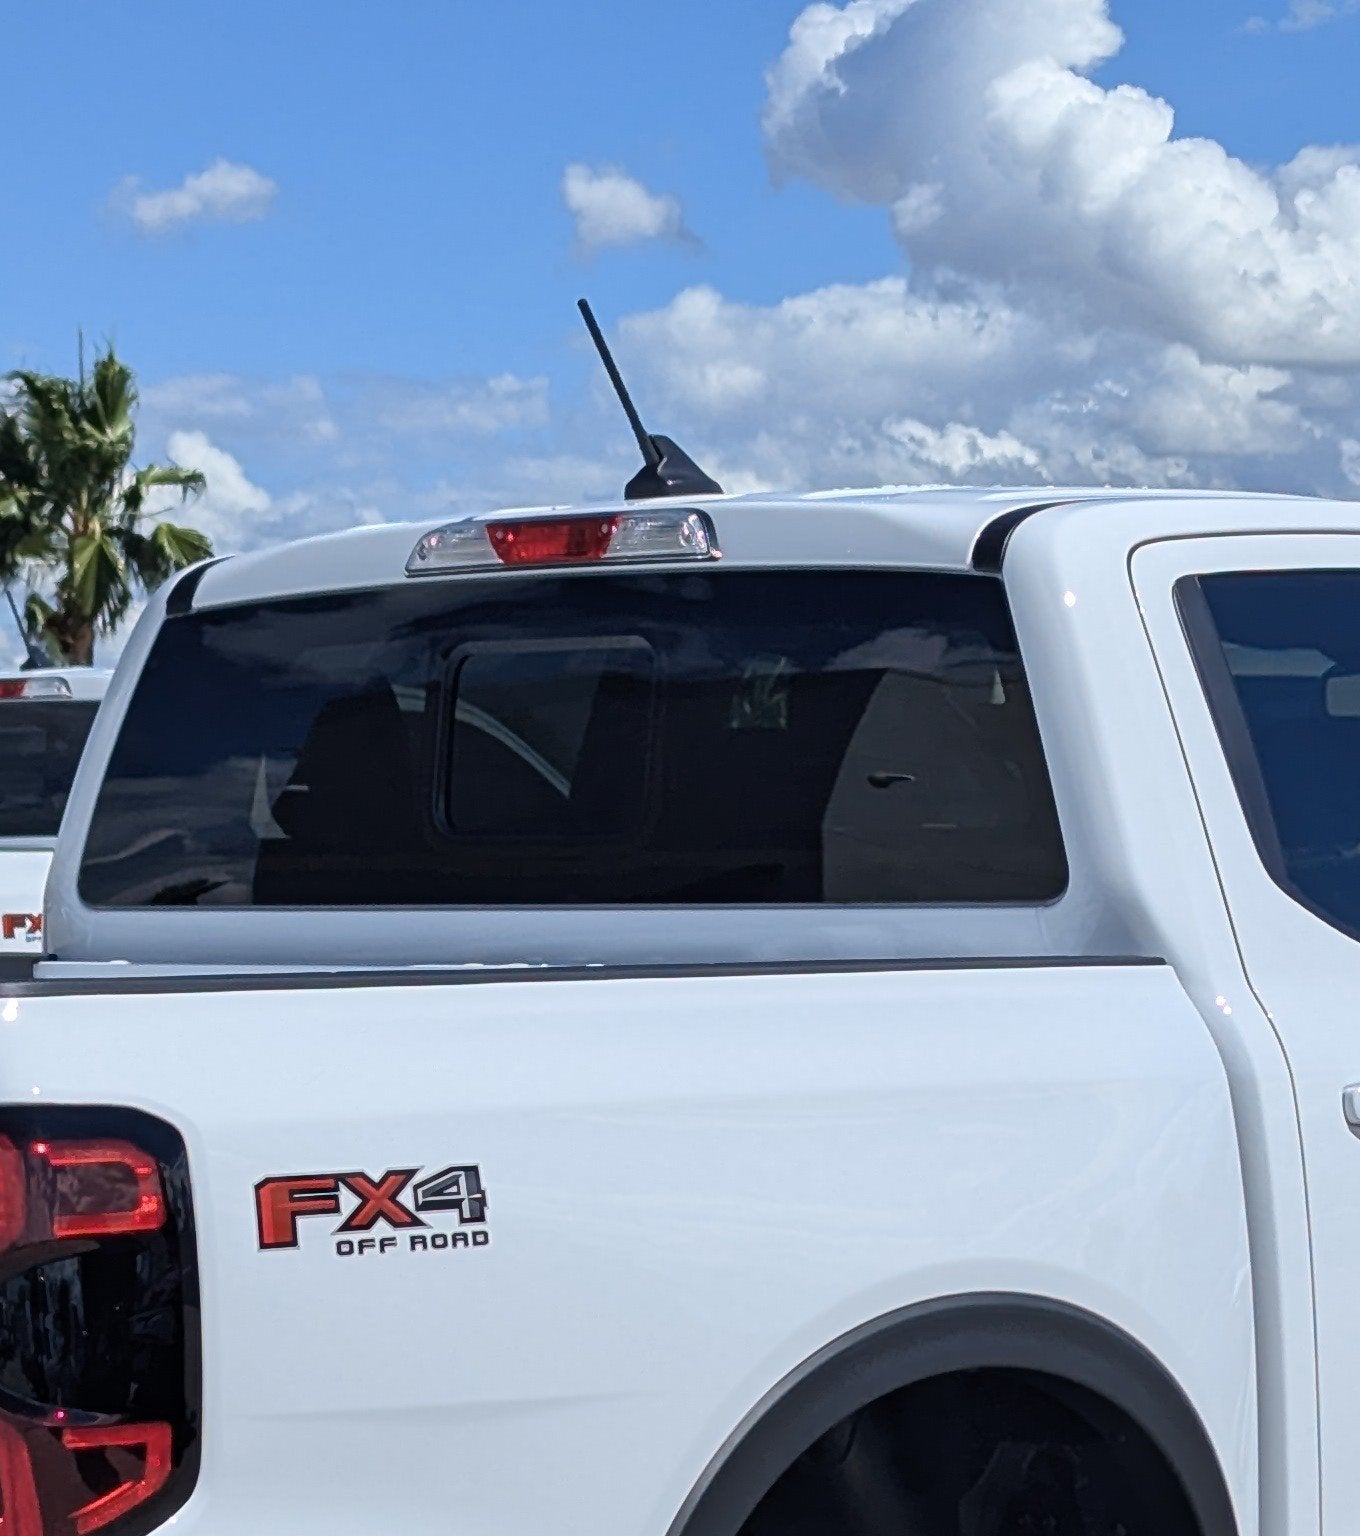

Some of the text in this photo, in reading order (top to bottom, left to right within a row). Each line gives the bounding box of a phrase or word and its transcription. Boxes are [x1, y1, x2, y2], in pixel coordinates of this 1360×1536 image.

[254, 1163, 489, 1252] FX4
[335, 1230, 490, 1256] OFF ROAD
